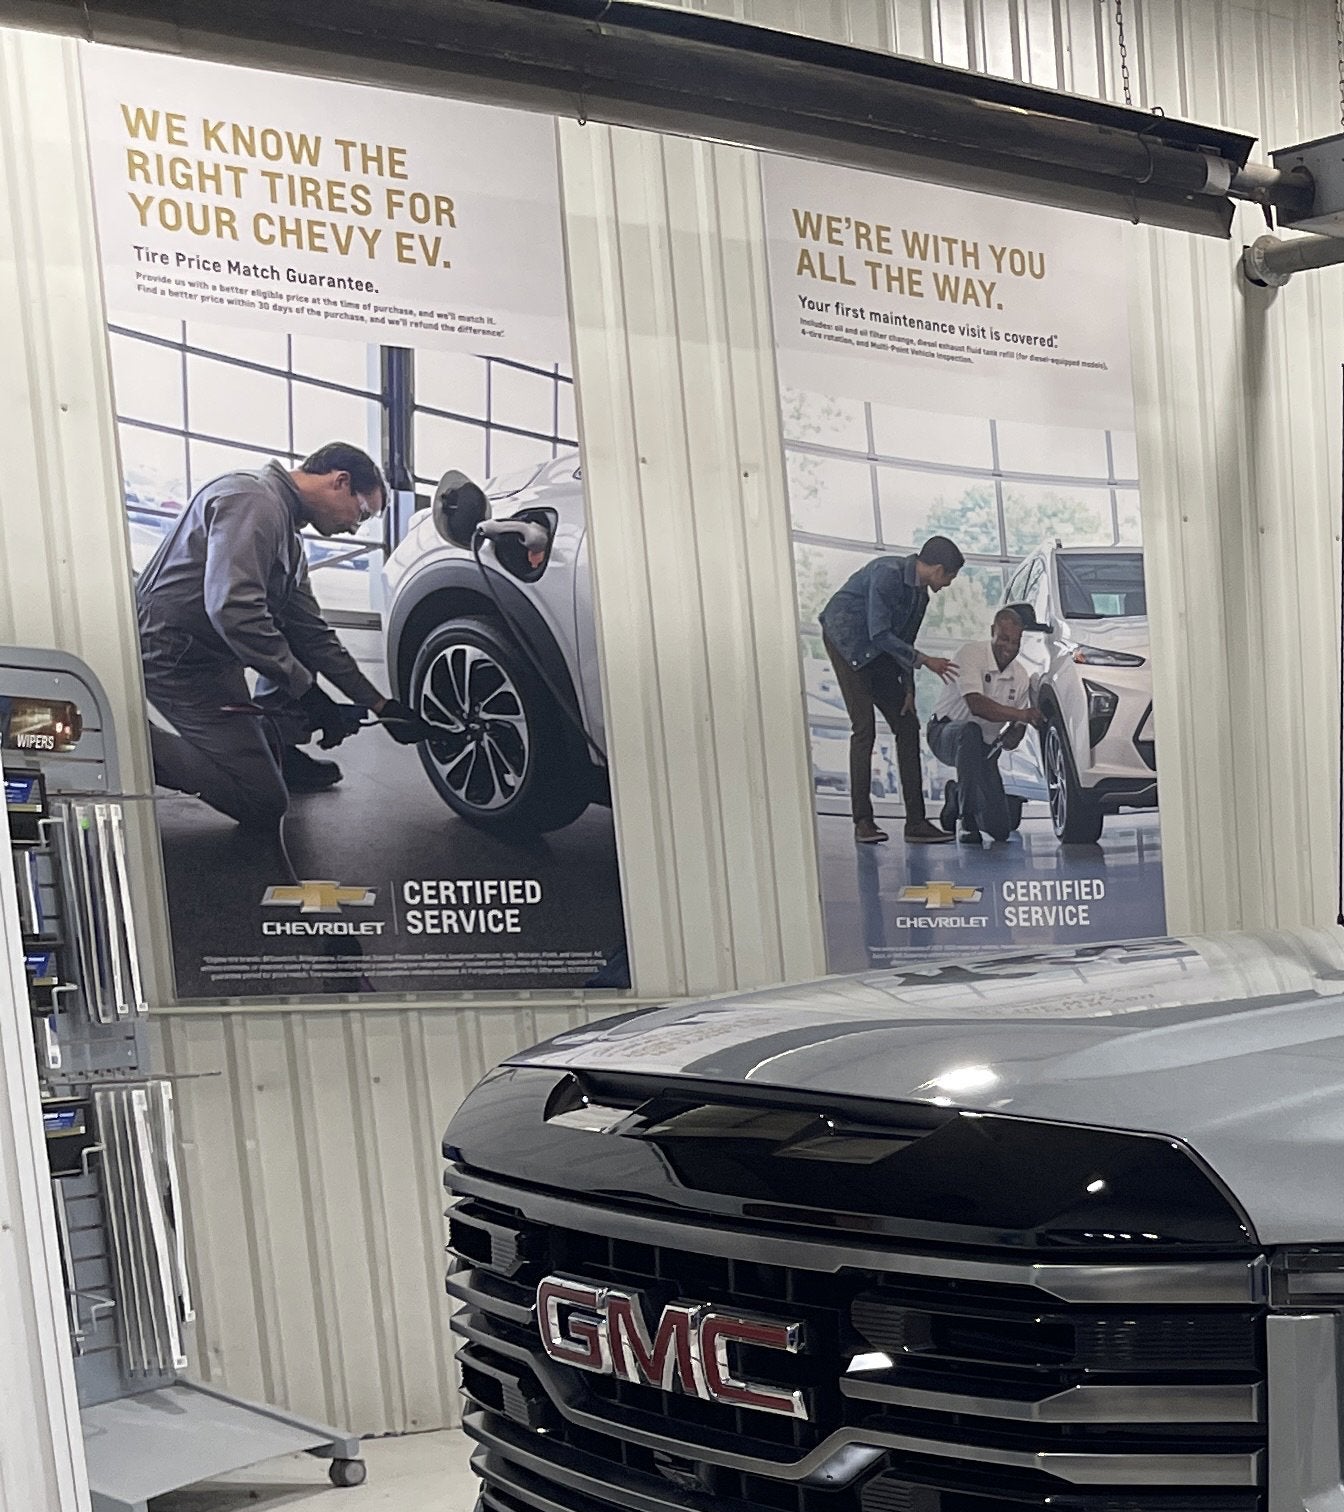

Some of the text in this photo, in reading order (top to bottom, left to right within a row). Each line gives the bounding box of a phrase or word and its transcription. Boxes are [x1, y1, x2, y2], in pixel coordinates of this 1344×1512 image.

[121, 104, 408, 180] WE KNOW THE
[126, 148, 456, 228] RIGHT TIRES FOR
[128, 191, 451, 268] YOUR CHEVY EV.
[791, 208, 1046, 280] WE'RE WITH YOU
[133, 245, 380, 294] Tire Price Match Guarantee.
[796, 249, 1004, 311] ALL THE WAY.
[136, 271, 172, 284] Provide
[175, 277, 186, 287] us
[188, 279, 209, 290] with
[219, 284, 248, 295] better
[251, 288, 283, 301] eligible
[286, 293, 309, 305] price
[312, 296, 321, 305] at
[323, 297, 338, 307] the
[340, 299, 360, 310] time
[362, 302, 371, 311] of
[374, 304, 416, 317] purchase,
[418, 309, 434, 319] and
[137, 284, 158, 295] Find
[168, 289, 198, 301] better
[201, 294, 225, 305] price
[227, 297, 255, 309] within
[258, 301, 269, 310] 30
[272, 303, 293, 315] days
[295, 306, 304, 315] of
[306, 307, 321, 317] the
[324, 310, 368, 323] purchase,
[370, 315, 385, 326] and
[441, 323, 455, 333] the
[798, 295, 831, 314] Your
[834, 300, 866, 320] first
[870, 311, 956, 334] maintenance
[958, 322, 987, 340] visit
[990, 326, 1001, 341] is
[17, 734, 54, 750] WIPERS
[403, 879, 542, 906] CERTIFIED
[1003, 879, 1105, 901] CERTIFIED
[262, 921, 386, 936] CHEVROLET
[405, 909, 522, 935] SERVICE
[896, 916, 989, 929] CHEVROLET
[1003, 905, 1091, 927] SERVICE
[536, 1273, 809, 1421] GMC
